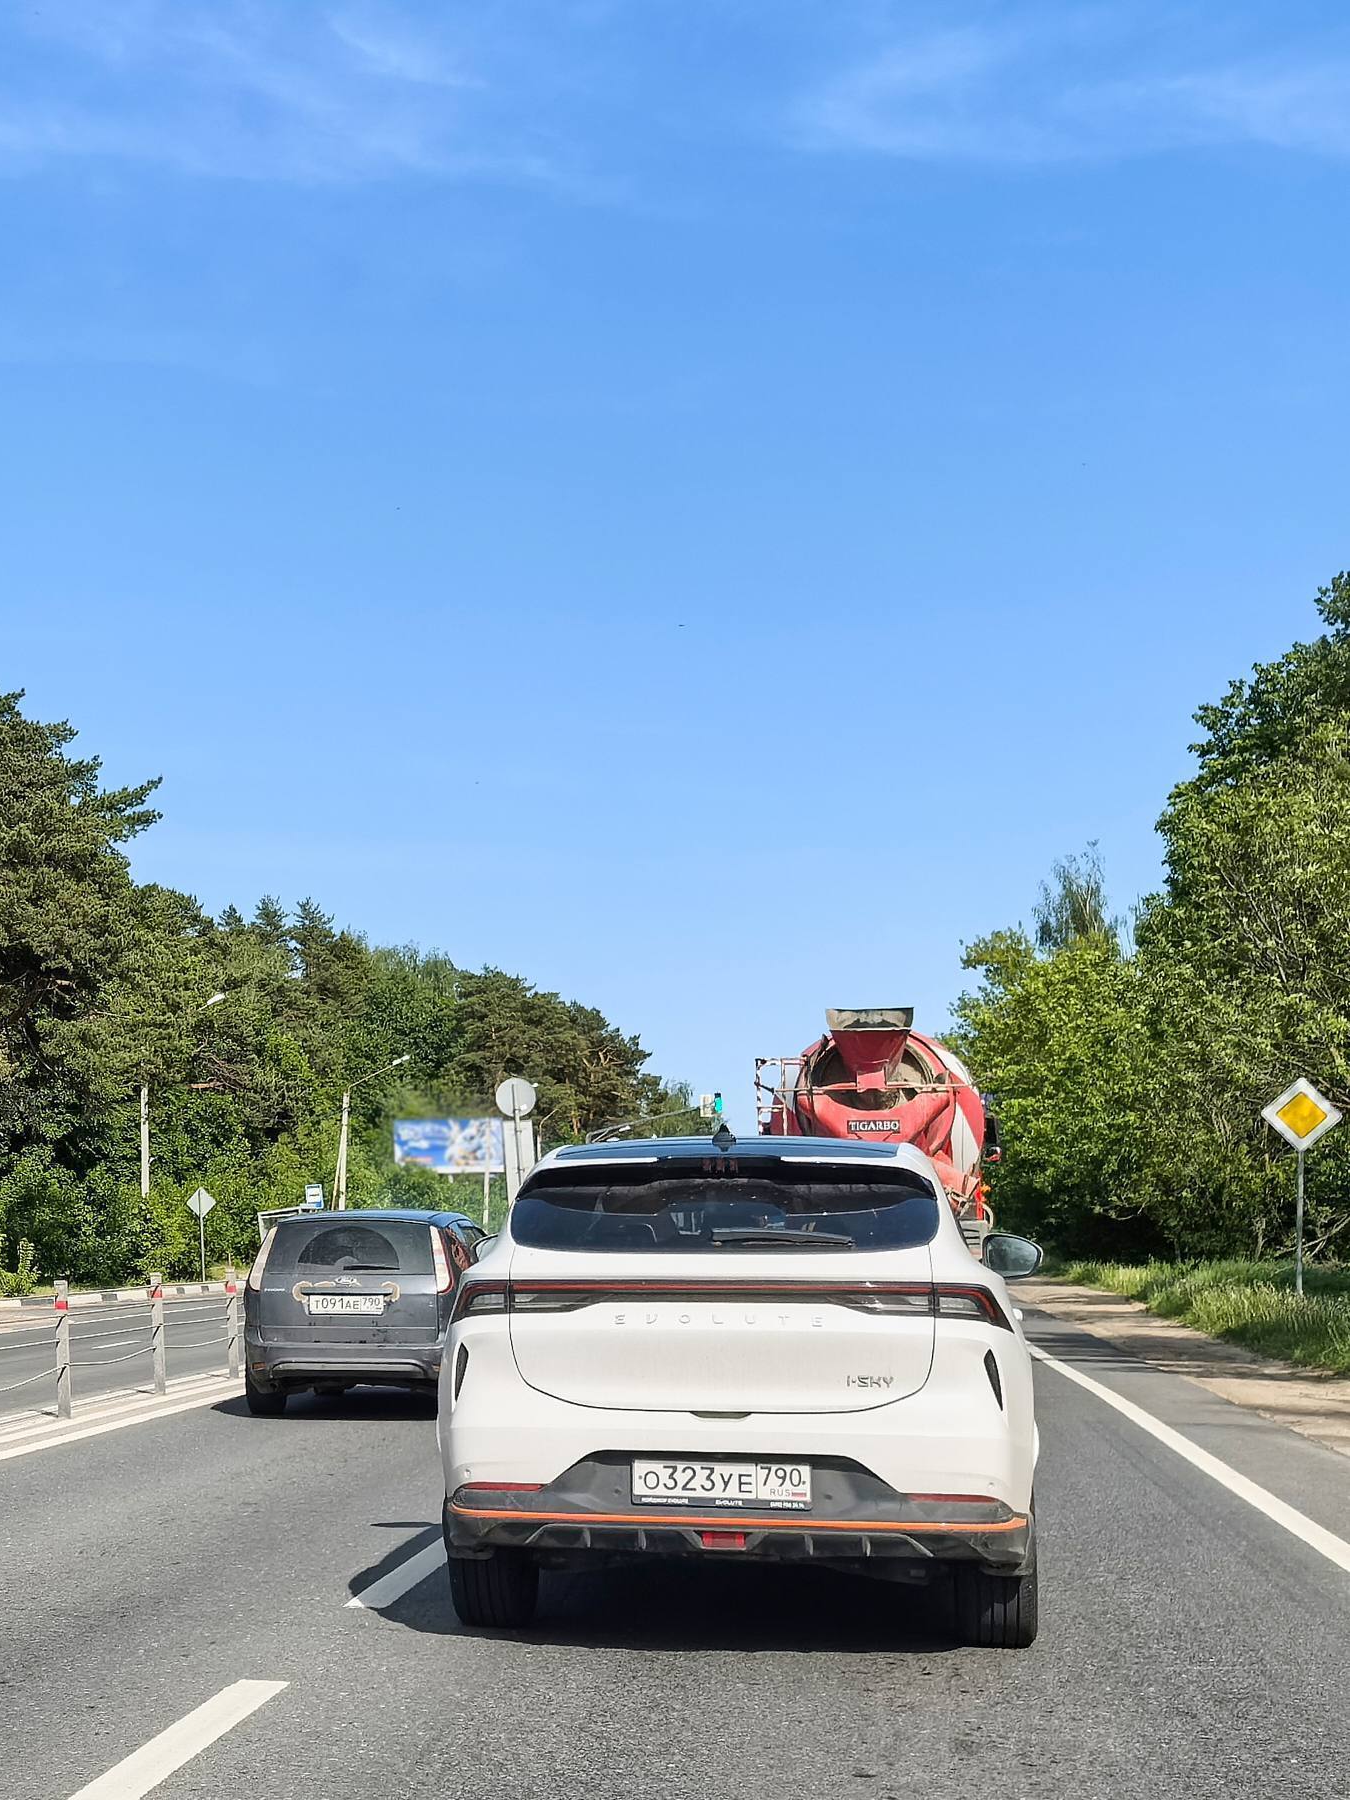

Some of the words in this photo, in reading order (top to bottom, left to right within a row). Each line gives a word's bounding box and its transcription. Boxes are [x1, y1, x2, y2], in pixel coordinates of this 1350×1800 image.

[848, 1121, 900, 1131] TIGARBO
[362, 1297, 381, 1307] 790
[613, 1313, 824, 1328] EVOLUTE
[759, 1465, 802, 1488] 790
[769, 1488, 791, 1498] RUS
